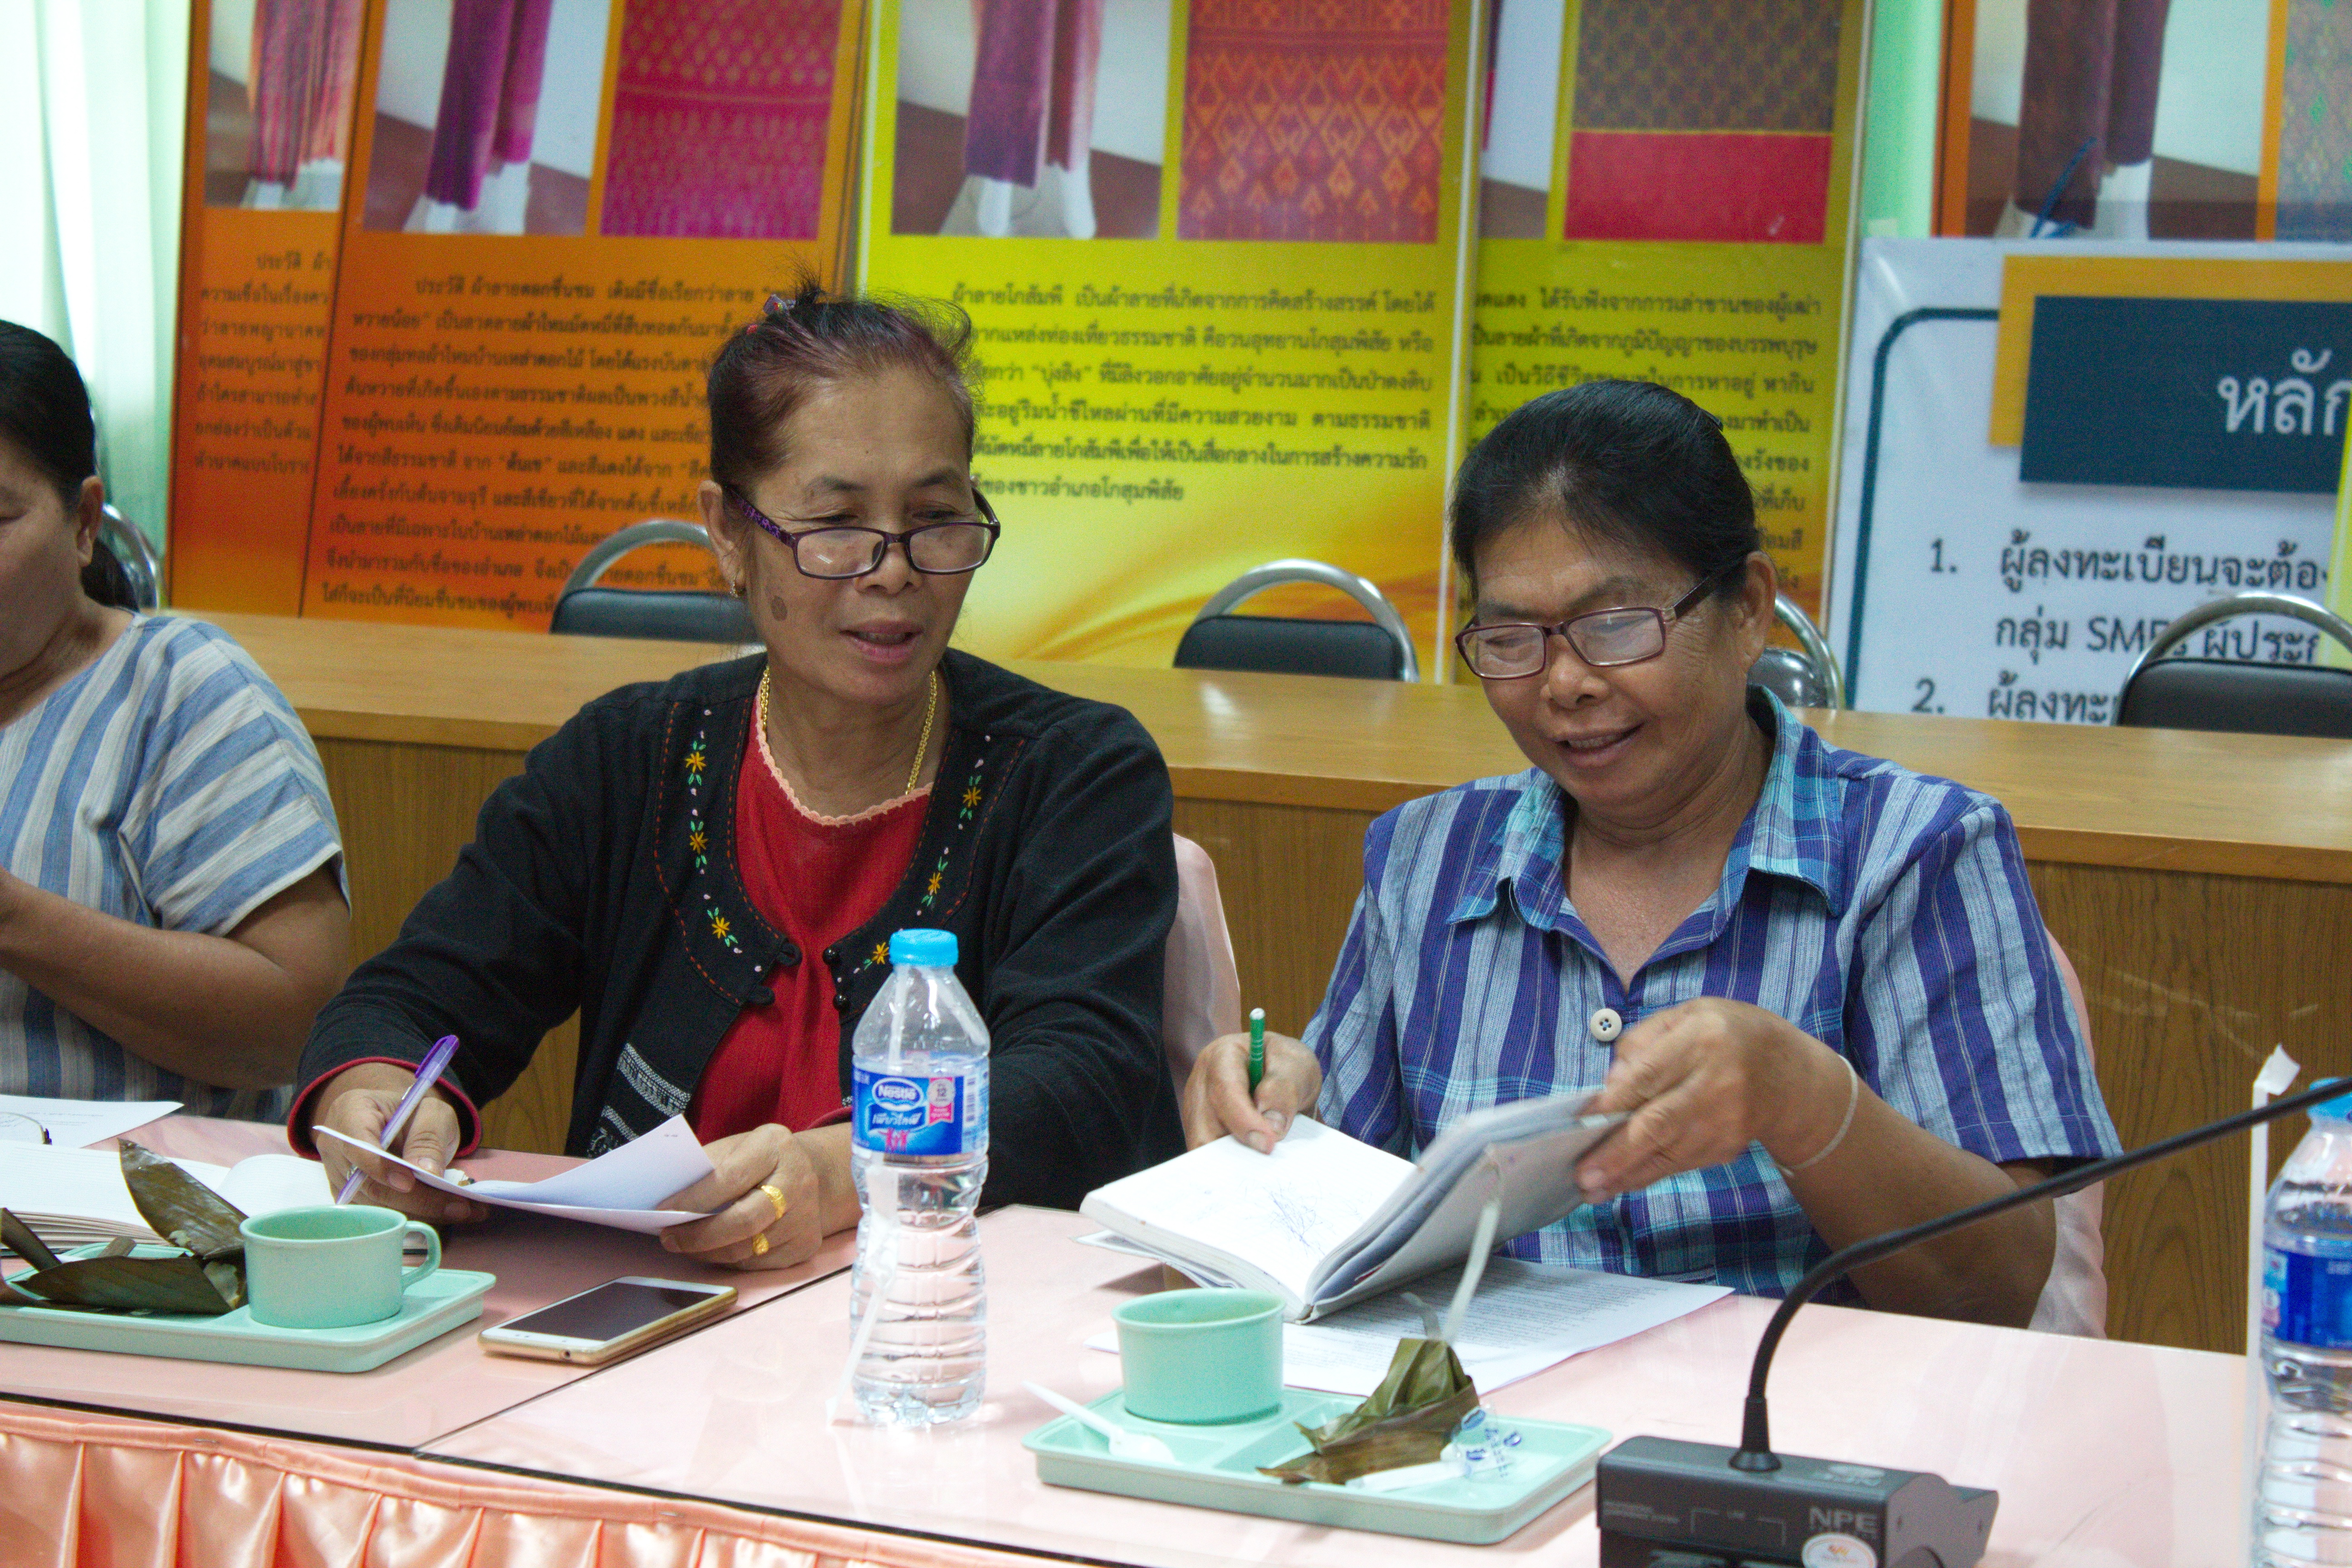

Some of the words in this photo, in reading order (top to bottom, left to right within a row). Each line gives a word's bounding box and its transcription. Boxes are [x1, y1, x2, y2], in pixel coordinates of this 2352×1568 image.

[1382, 289, 1436, 314] โดยได้
[970, 318, 1197, 346] จากแหล่งท่องเที่ยวธรรมชาติ
[1398, 329, 1434, 353] หรือ
[1472, 321, 1818, 362] ป็นลายผ้าที่เกิดจากภูมิปัญญาของบรรพบุรุษ
[975, 392, 1298, 426] ละอยู่ริมน้ำชีไหลผ่านที่มีความสวยงาม
[1311, 407, 1432, 431] ตามธรรมชาติ
[1930, 539, 1959, 574] 1.
[1999, 528, 2329, 594] ผู้ลงทะเบียนจะต้อ
[1995, 605, 2069, 666] กลุ่ม
[1913, 678, 1945, 715] 2.
[1809, 1506, 1879, 1535] NPE
